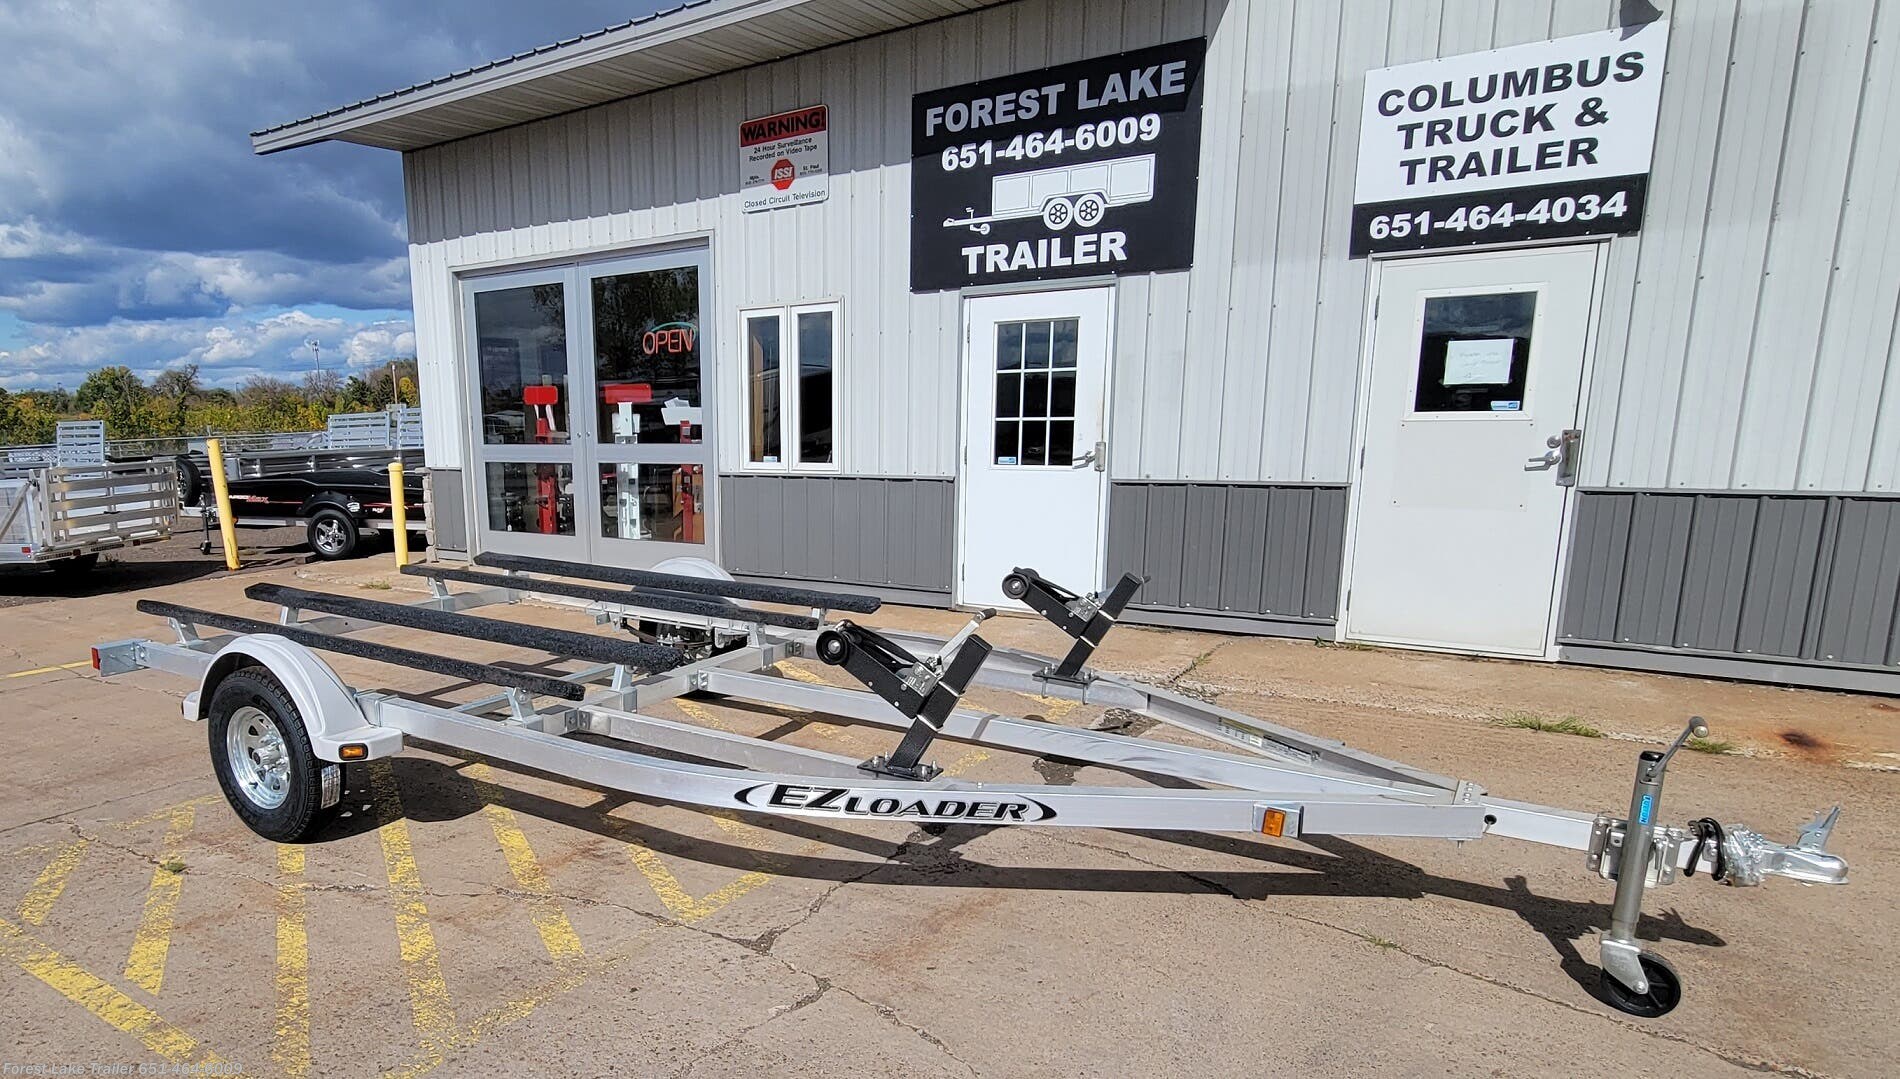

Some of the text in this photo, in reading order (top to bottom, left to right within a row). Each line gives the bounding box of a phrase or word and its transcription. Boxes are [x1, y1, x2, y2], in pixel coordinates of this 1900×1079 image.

[925, 60, 1187, 137] FOREST LAKE
[1378, 51, 1644, 117] COLUMBUS
[741, 112, 825, 141] WARNING!
[941, 112, 1161, 171] 651-464-6009
[1397, 97, 1609, 150] TRUCK &
[749, 144, 818, 162] Recorded on Video Tape
[762, 144, 776, 152] Hour
[1399, 137, 1599, 186] TRAILER
[774, 166, 793, 180] ISSI
[744, 189, 826, 208] Closed Circuit Television
[1369, 191, 1628, 240] 651-464-4034
[961, 231, 1128, 274] TRAILER
[643, 328, 693, 355] OPEN
